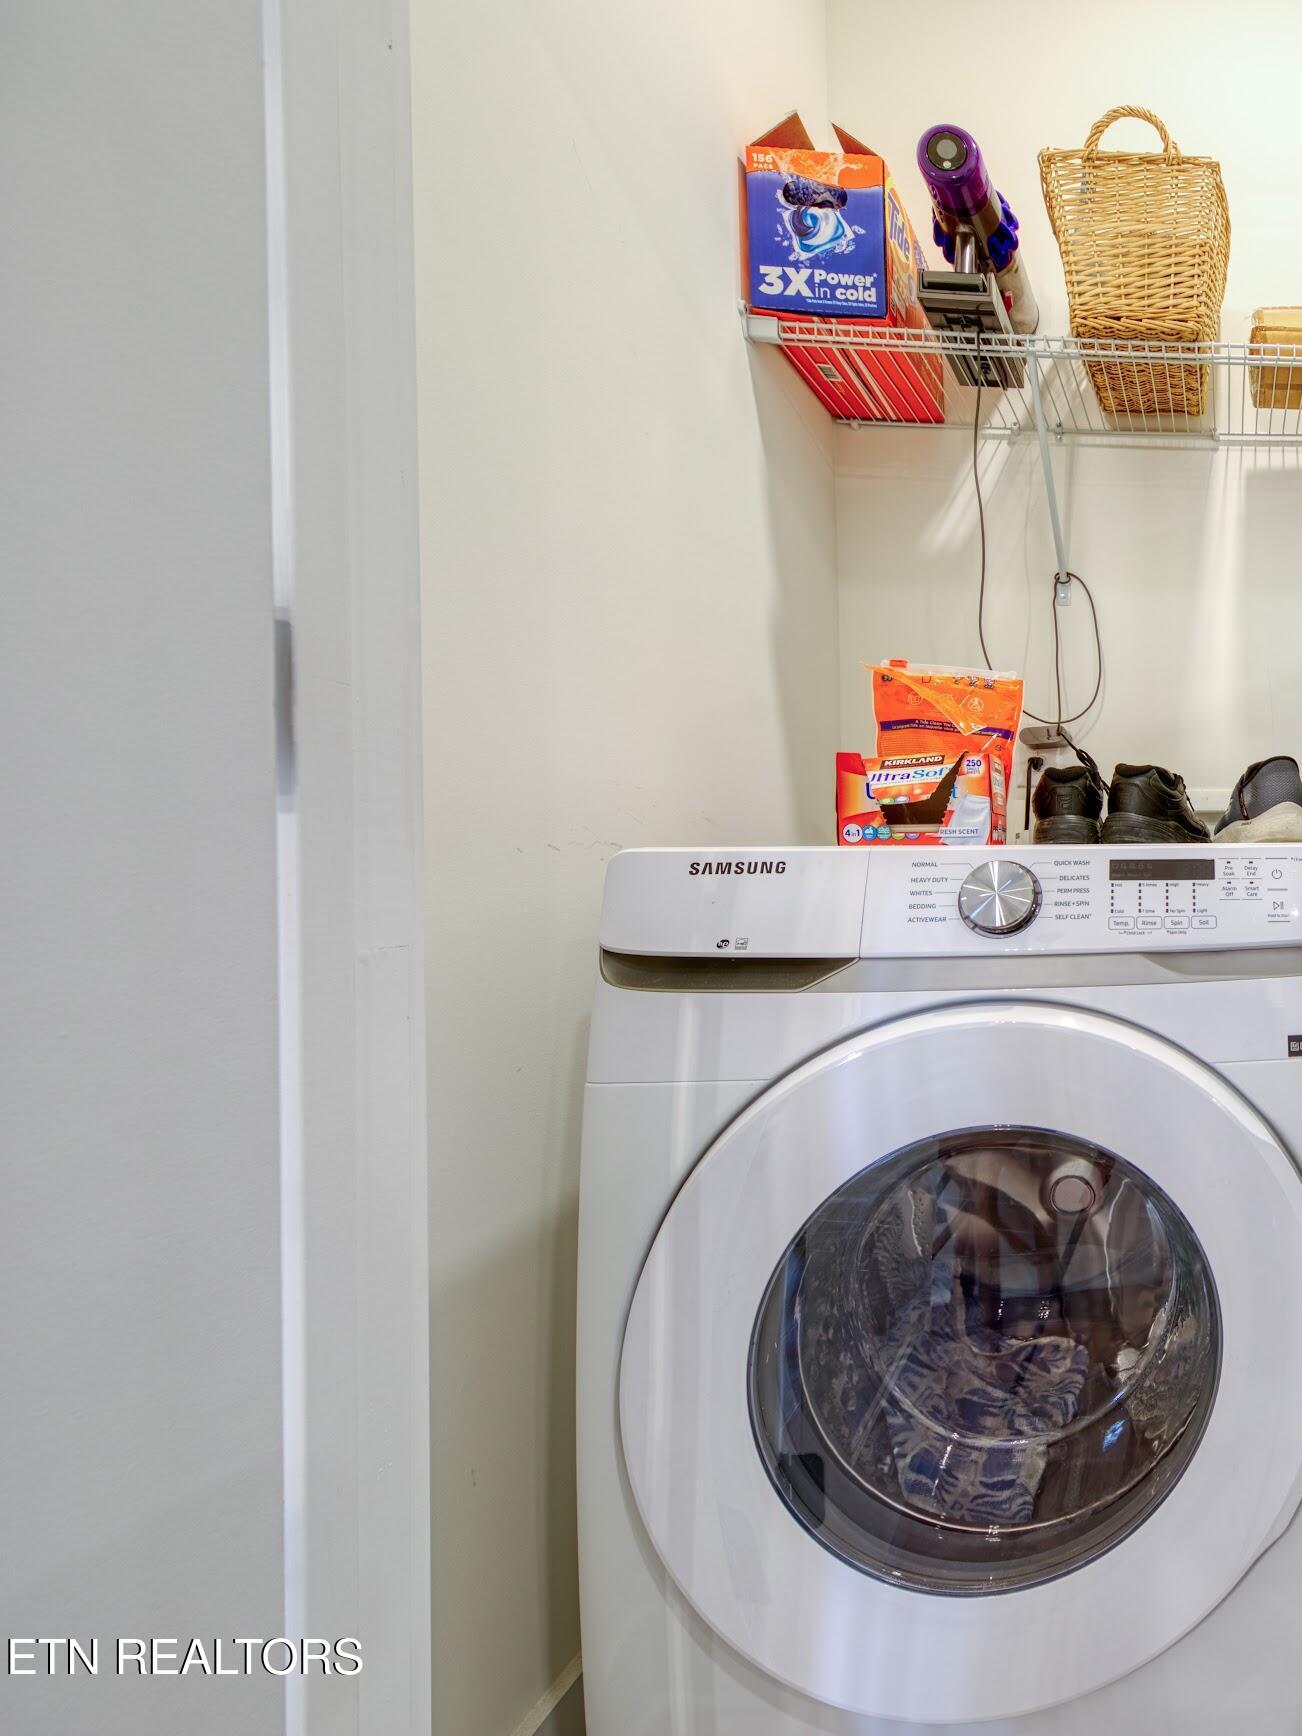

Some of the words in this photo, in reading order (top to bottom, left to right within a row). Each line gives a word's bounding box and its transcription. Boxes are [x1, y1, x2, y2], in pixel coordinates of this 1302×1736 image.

[752, 153, 773, 162] 156
[887, 191, 910, 262] Tide
[758, 265, 814, 297] 3X
[815, 284, 830, 298] in
[835, 287, 877, 303] cold
[884, 756, 942, 766] KIRKLAND
[966, 759, 982, 767] 250
[688, 861, 787, 875] SAMSUNG
